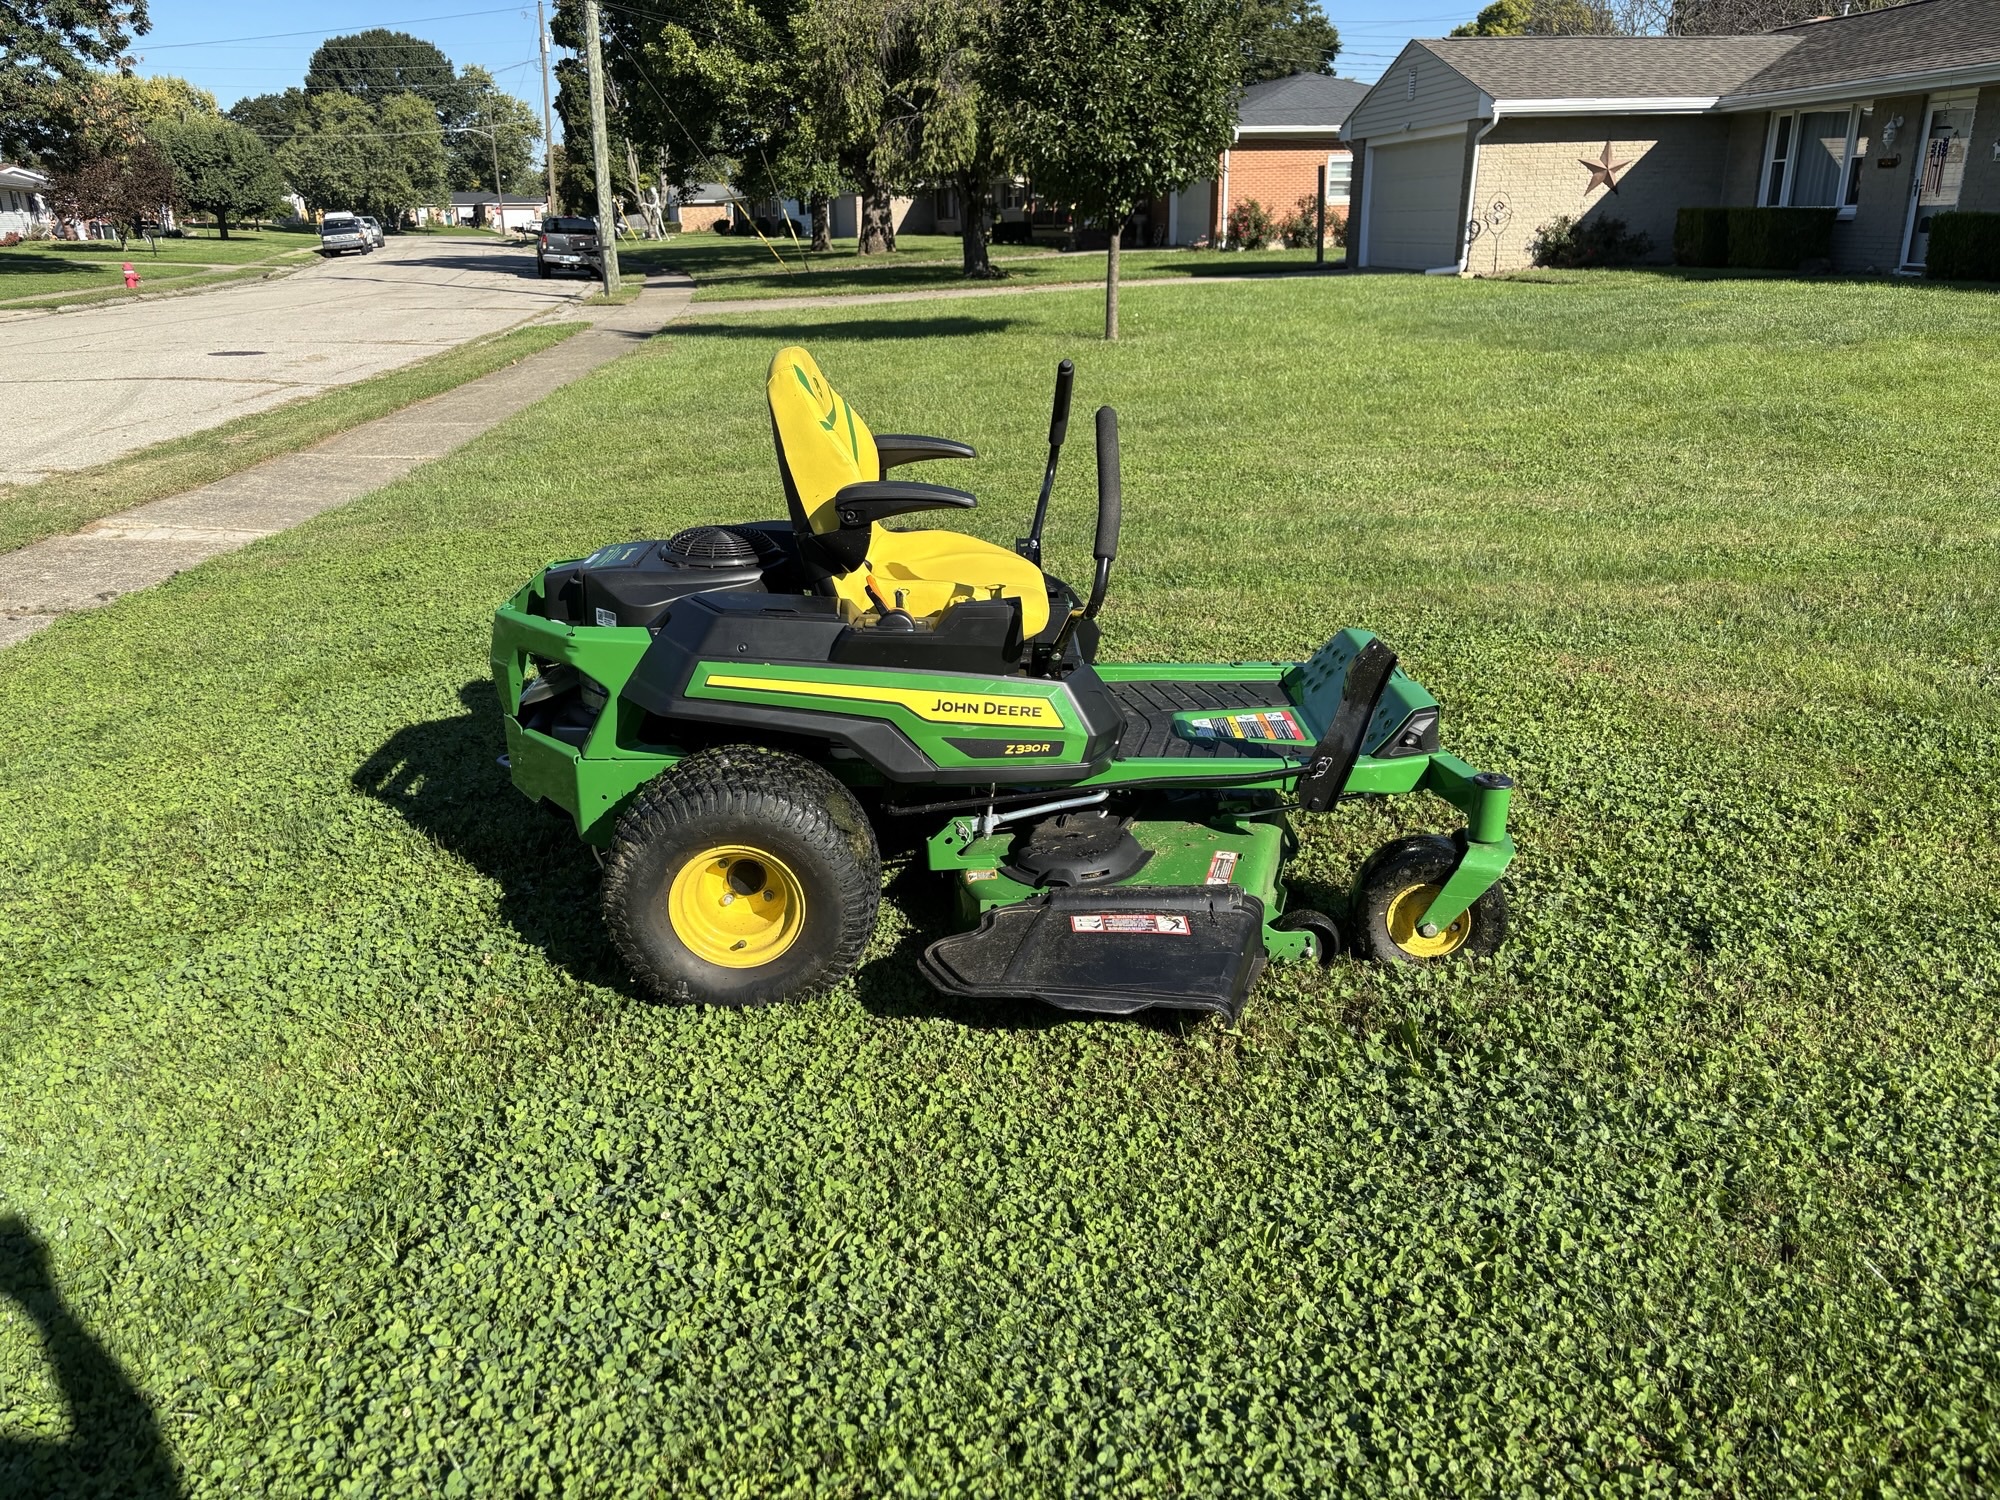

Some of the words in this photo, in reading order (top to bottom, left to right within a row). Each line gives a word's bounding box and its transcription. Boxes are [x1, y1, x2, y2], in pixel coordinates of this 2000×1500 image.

[931, 699, 979, 714] JOHN
[983, 702, 1042, 717] DEERE
[1004, 744, 1051, 755] Z330R
